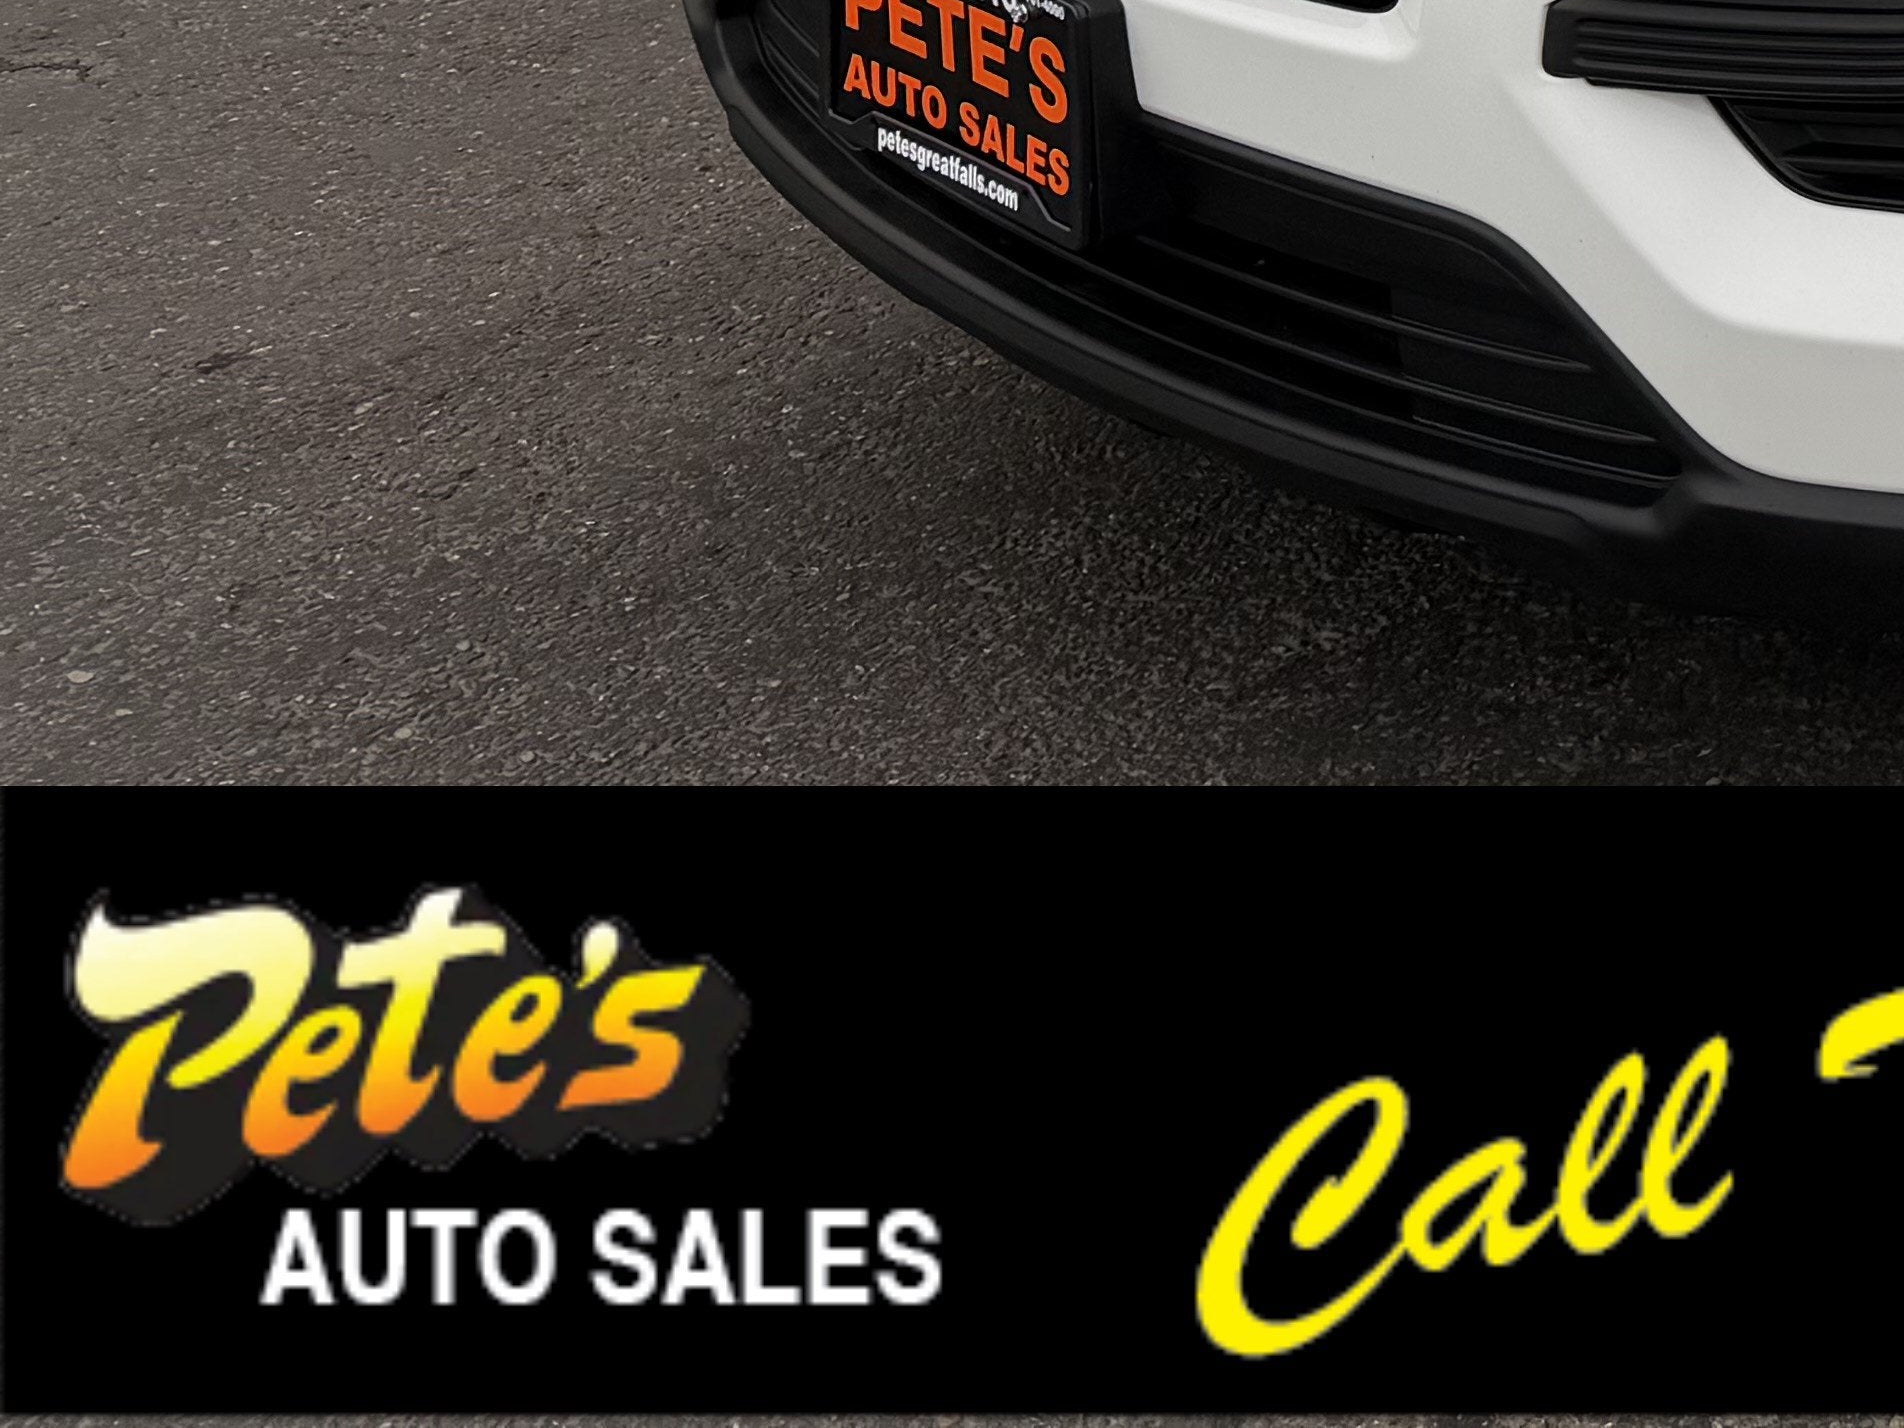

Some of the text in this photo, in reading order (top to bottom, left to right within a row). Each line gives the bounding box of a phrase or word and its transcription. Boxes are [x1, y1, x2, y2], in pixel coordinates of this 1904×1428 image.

[843, 53, 1070, 196] AUTO SALES
[877, 126, 1019, 212] petesgreatfalls.com
